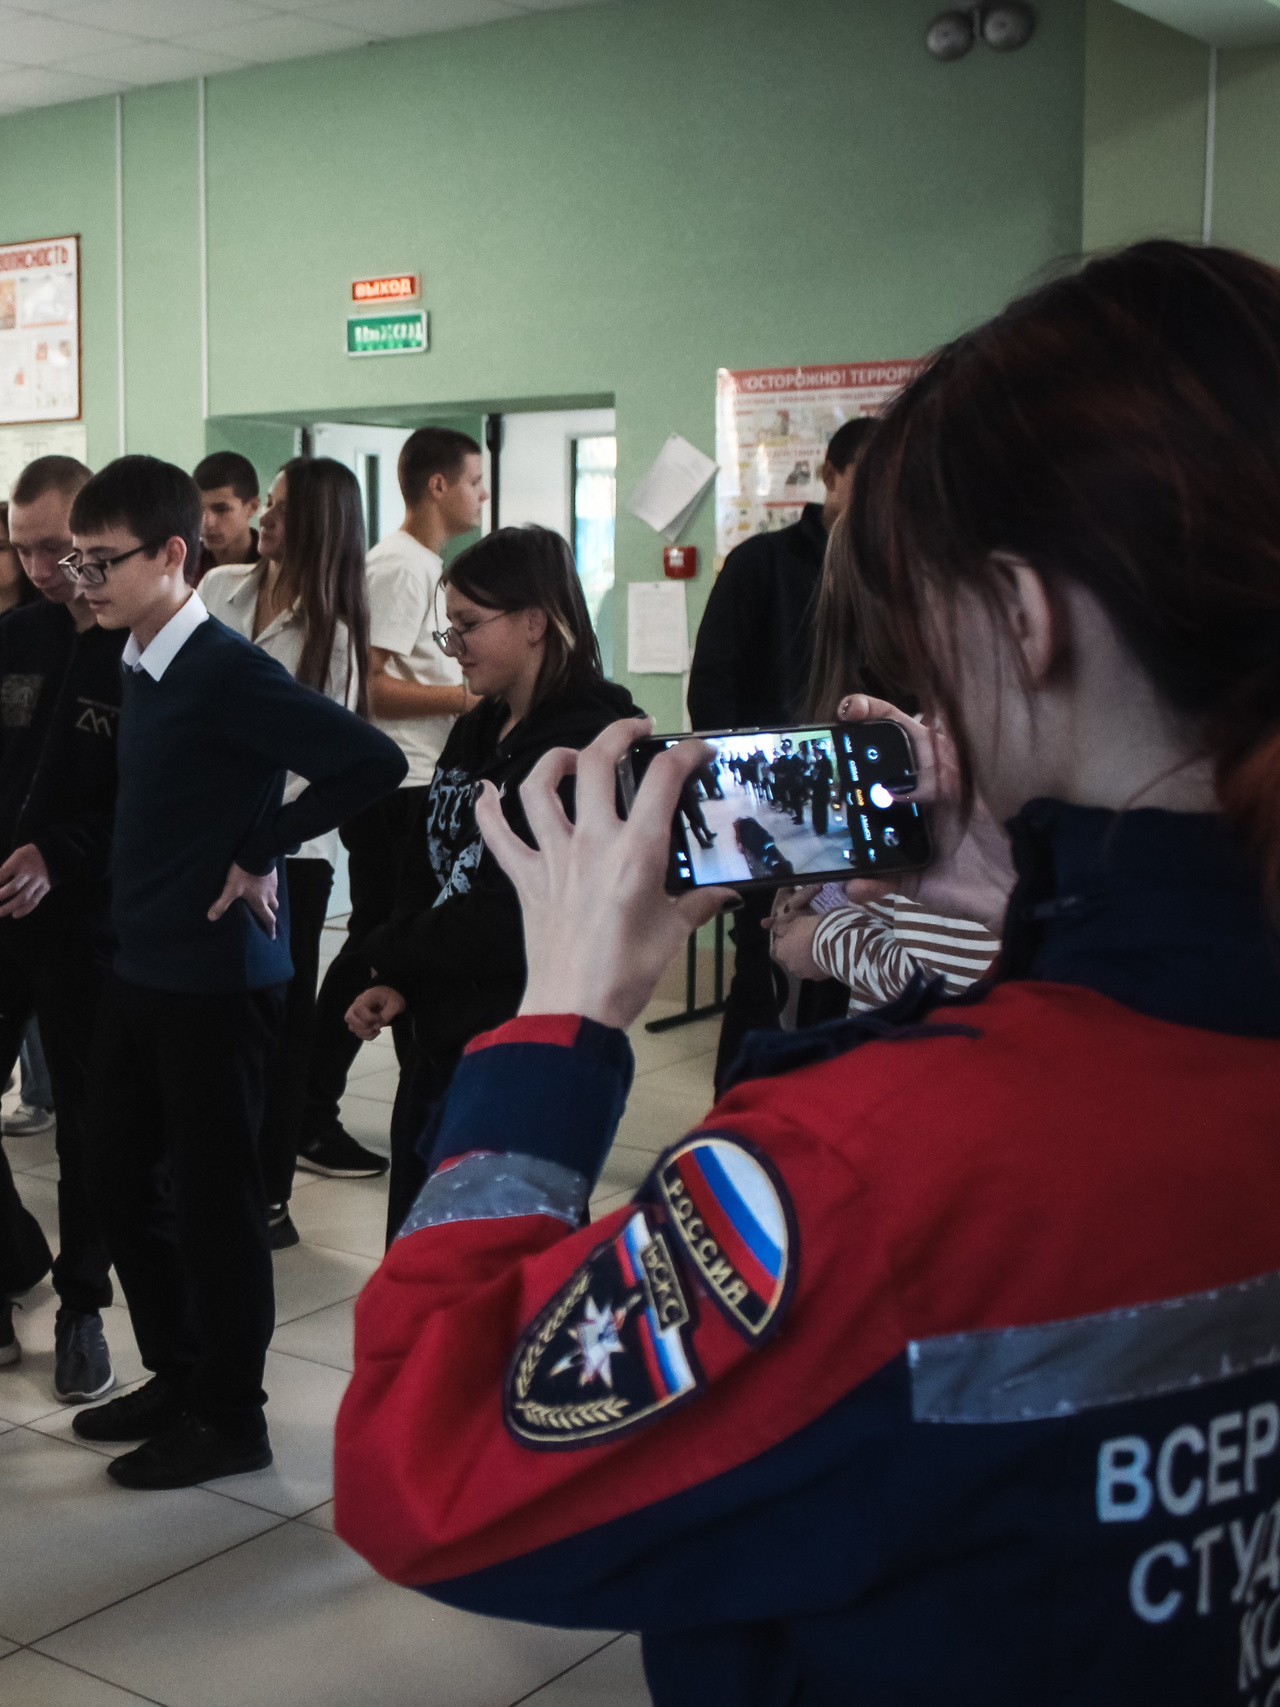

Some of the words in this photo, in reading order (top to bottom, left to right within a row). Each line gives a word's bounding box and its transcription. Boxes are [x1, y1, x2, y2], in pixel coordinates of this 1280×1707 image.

[355, 278, 411, 298] ВЫХОД
[851, 365, 918, 384] ТЕРРОР
[855, 789, 865, 806] ФОТО
[667, 1177, 749, 1306] РОССИЯ
[1097, 1403, 1280, 1522] ВСЕР
